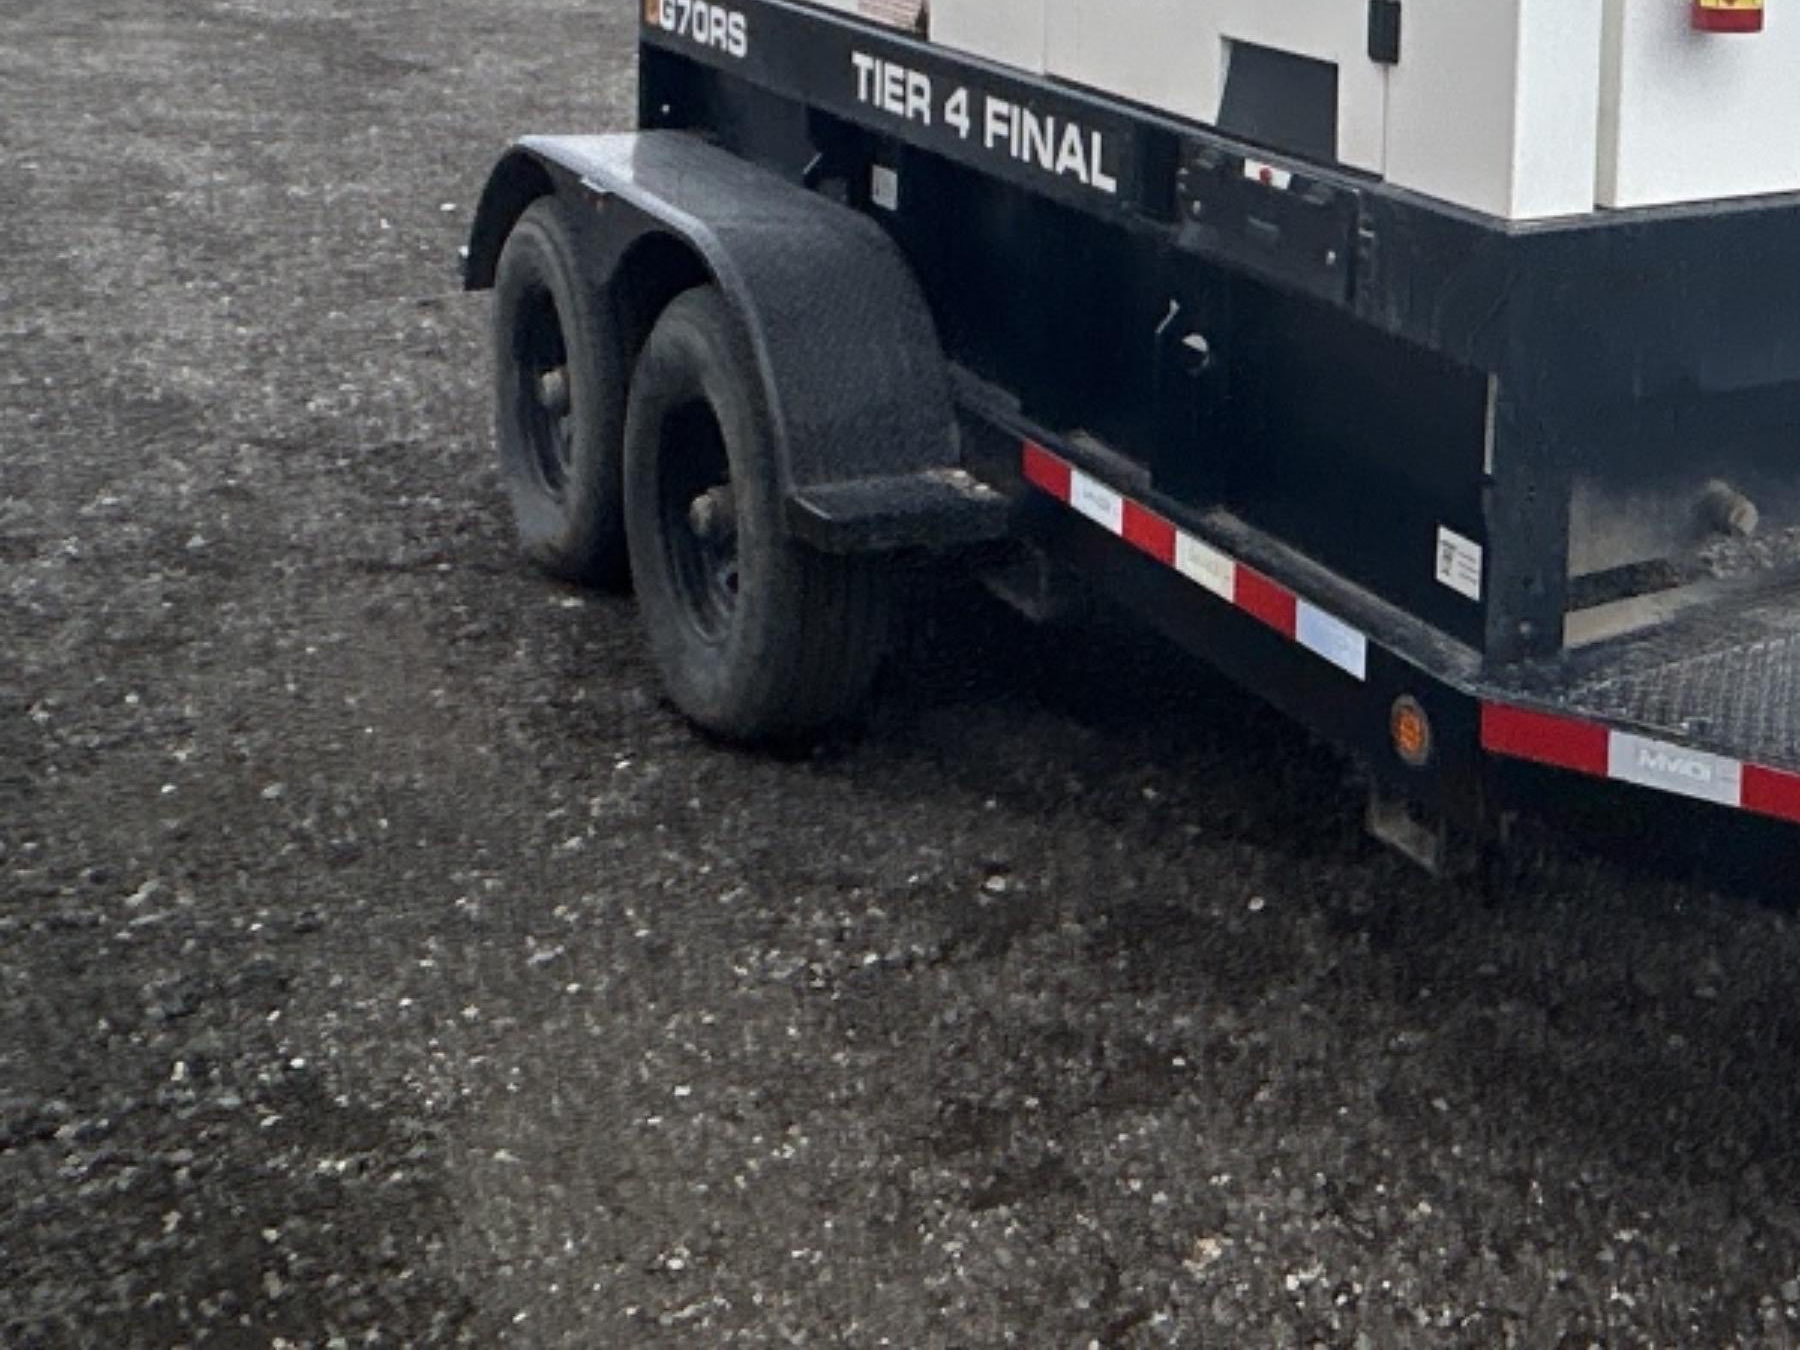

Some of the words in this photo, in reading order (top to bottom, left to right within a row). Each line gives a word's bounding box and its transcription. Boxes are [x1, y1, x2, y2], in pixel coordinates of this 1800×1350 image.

[851, 50, 932, 127] TIER
[944, 86, 971, 140] 4
[984, 95, 1118, 194] FINAL
